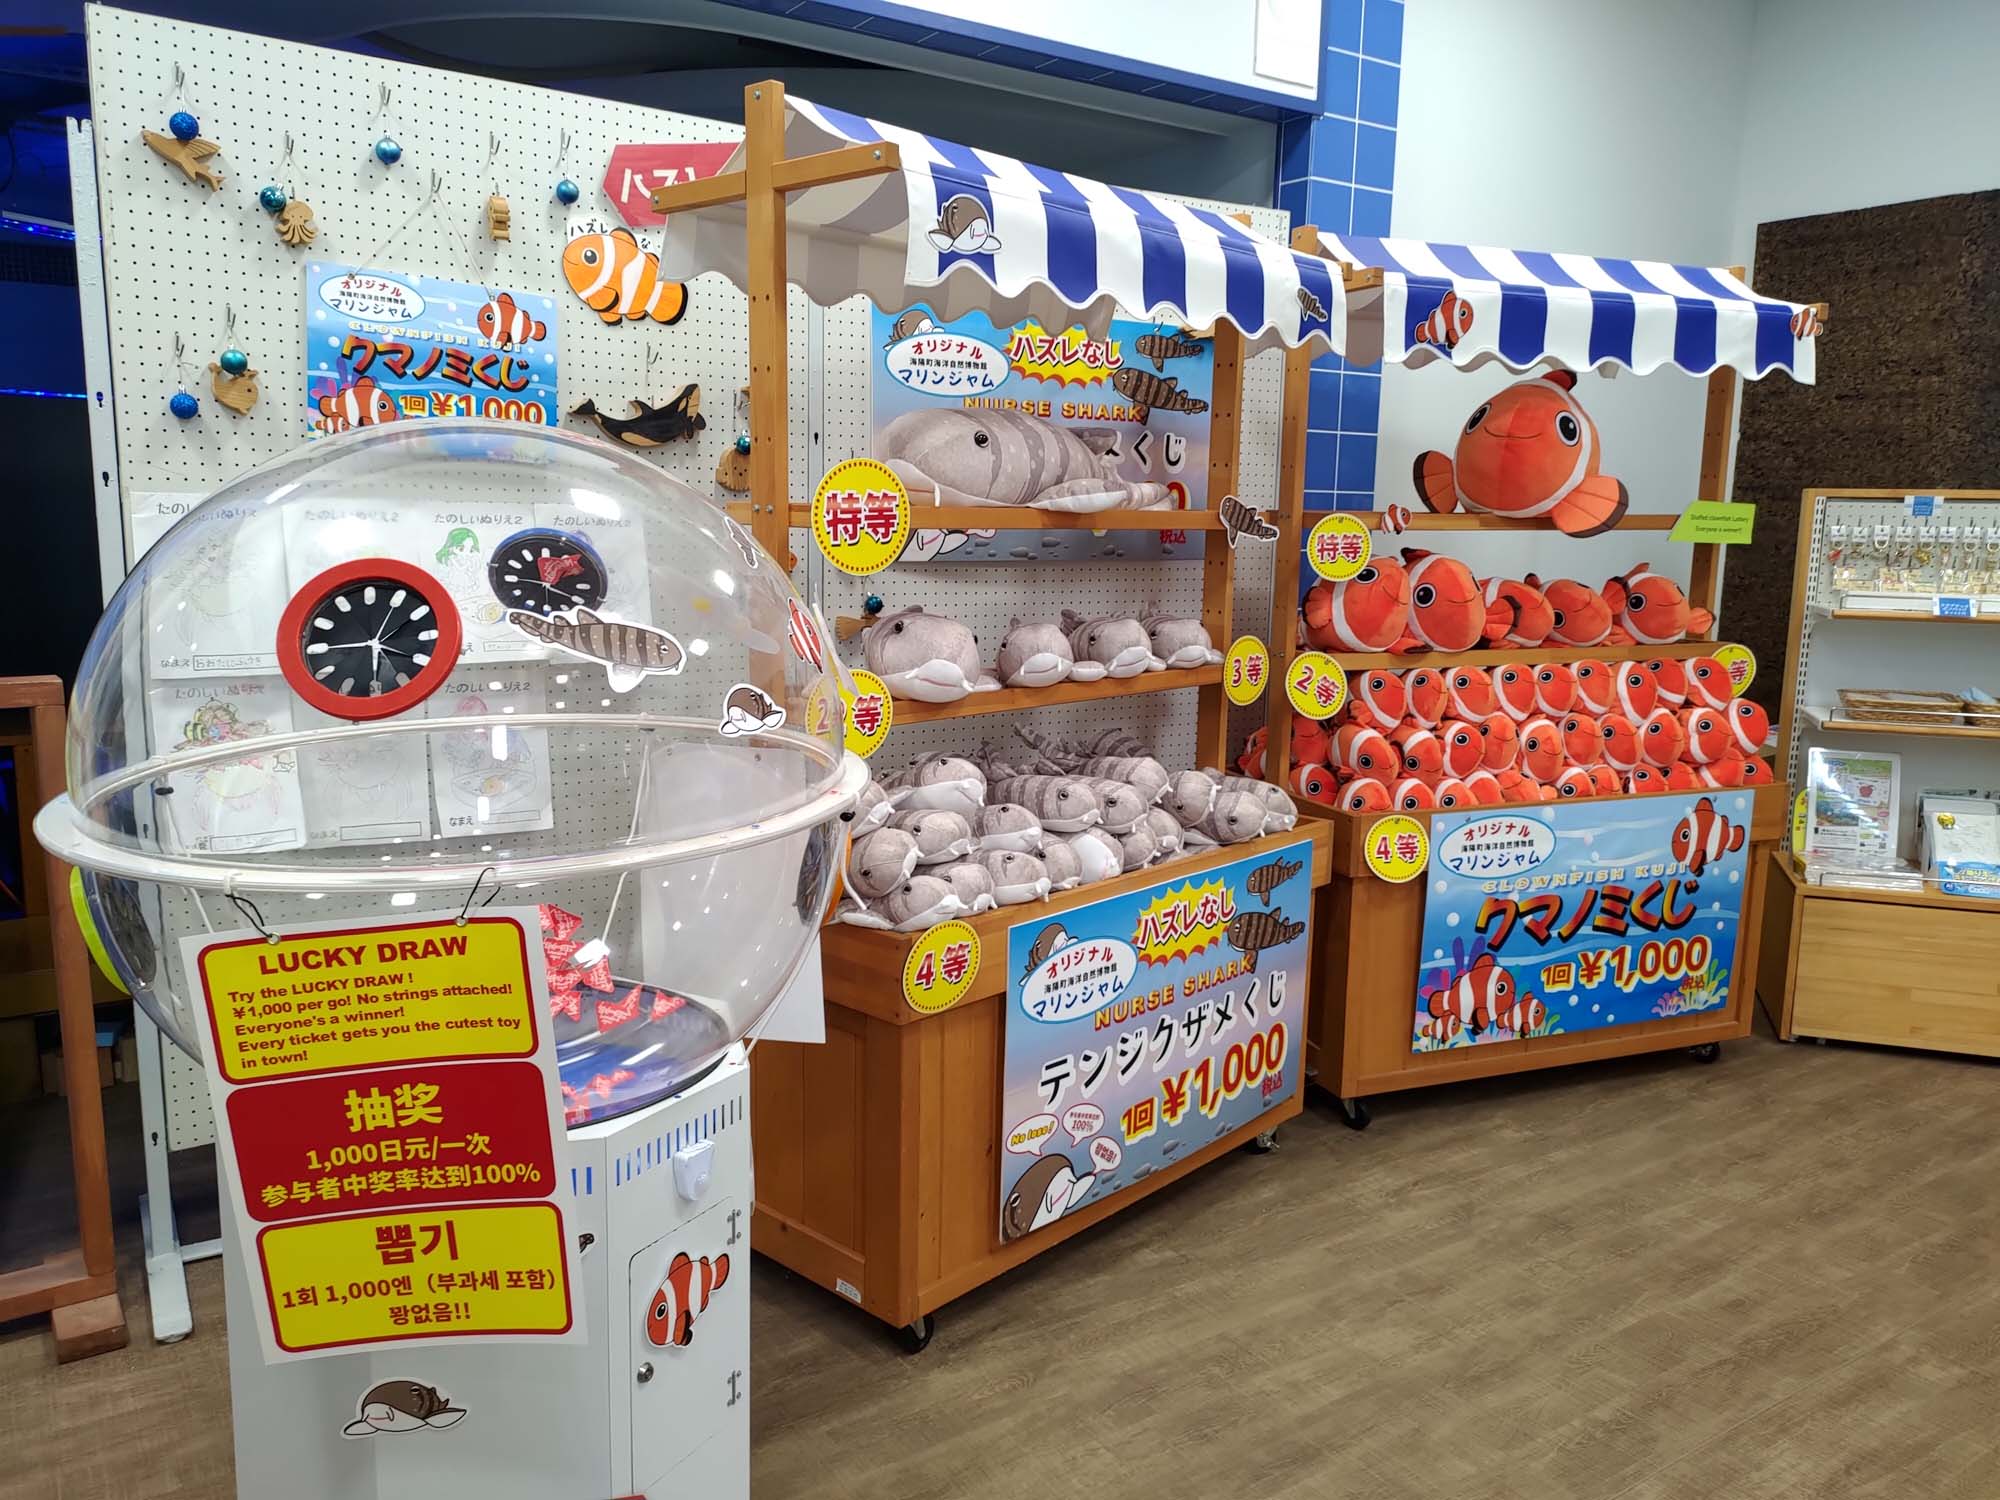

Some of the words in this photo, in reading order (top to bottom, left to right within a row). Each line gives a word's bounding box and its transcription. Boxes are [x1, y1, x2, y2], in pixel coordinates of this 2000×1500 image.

[341, 279, 402, 297] オリジナル
[329, 297, 412, 319] マリンジャム
[341, 334, 530, 391] クマノミくじ
[911, 339, 983, 360] オリジナル
[1011, 334, 1124, 369] ハズレなし
[898, 369, 994, 388] マリンジャム
[1062, 402, 1142, 422] SHARK
[434, 513, 523, 526] たのしいぬりえ2
[825, 491, 899, 546] 特等
[1316, 533, 1364, 564] 特等
[445, 681, 531, 695] たのしいりえ2
[1232, 655, 1263, 688] 3等
[1294, 665, 1341, 707] 2等
[449, 815, 473, 826] なまえ
[1464, 821, 1531, 842] オリジナル
[1376, 833, 1419, 864] 4等
[1450, 850, 1541, 872] マリンジャム
[1481, 867, 1625, 894] CLOWNFISH
[1634, 861, 1688, 877] KUJI
[1136, 887, 1238, 950] ハズレなし
[1475, 879, 1700, 951] クマノミくじ
[259, 945, 367, 976] LUCKY
[377, 935, 468, 964] DRAW
[914, 942, 972, 991] 4等
[1047, 945, 1113, 980] オリジナル
[1543, 964, 1573, 991] 1回
[1578, 936, 1711, 991] ¥1,000
[228, 990, 256, 1004] Try
[260, 983, 289, 997] the
[291, 979, 350, 996] LUCKY
[354, 973, 404, 989] DRAW
[232, 1001, 293, 1020] ¥1,000
[296, 1002, 325, 1015] per
[328, 995, 352, 1011] go!
[357, 992, 380, 1005] No
[383, 986, 439, 1005] strings
[442, 983, 513, 997] attached!
[1033, 974, 1125, 1017] マリンジャム
[1094, 983, 1175, 1032] NURSE
[1183, 953, 1254, 998] SHARK
[235, 1015, 327, 1037] Everyone's
[330, 1015, 340, 1025] a
[345, 1006, 406, 1023] winner!
[238, 1037, 286, 1055] Every
[289, 1030, 338, 1046] ticket
[342, 1026, 378, 1042] gets
[382, 1023, 411, 1036] you
[415, 1019, 441, 1032] the
[445, 1016, 494, 1030] cutest
[497, 1016, 521, 1030] toy
[1040, 971, 1287, 1106] テンジクザメくじ
[241, 1057, 256, 1069] in
[261, 1049, 309, 1067] town!
[1121, 1097, 1156, 1139] 1回
[1160, 1022, 1287, 1120] ¥1,000
[343, 1082, 444, 1132] 抽奖
[306, 1132, 492, 1172] 1,000日元/一次
[261, 1162, 541, 1208] 参与者中奖率达到100%
[375, 1219, 459, 1266] 뽑기
[281, 1284, 318, 1309] 1회
[326, 1275, 413, 1304] 1,000엔
